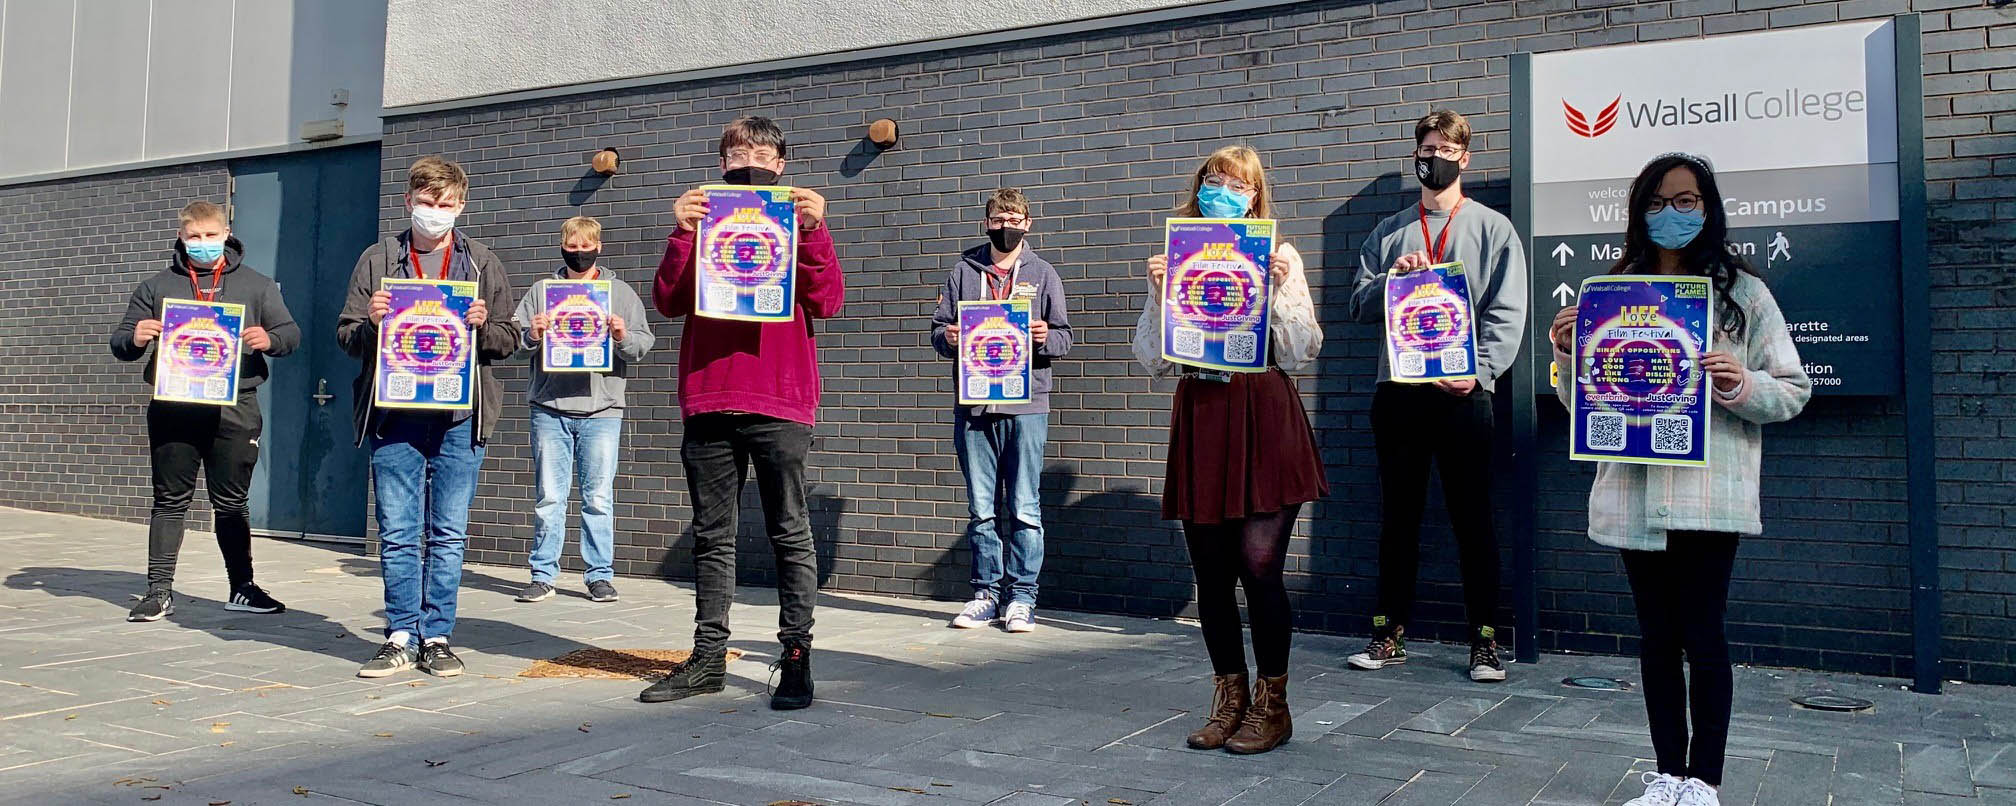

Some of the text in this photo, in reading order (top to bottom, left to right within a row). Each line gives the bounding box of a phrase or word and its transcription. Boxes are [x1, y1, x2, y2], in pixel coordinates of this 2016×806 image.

[1626, 88, 1865, 129] Walsall College
[1588, 186, 1630, 200] welco
[1589, 197, 1826, 222] Wis Campus
[1591, 241, 1756, 261] Ma on
[1222, 314, 1261, 323] JustGiving
[1786, 320, 1828, 332] arette
[1608, 329, 1674, 338] Film Festival
[1795, 334, 1842, 344] designated
[1804, 362, 1833, 374] tion
[1586, 392, 1696, 404] eventbrite JustGiving
